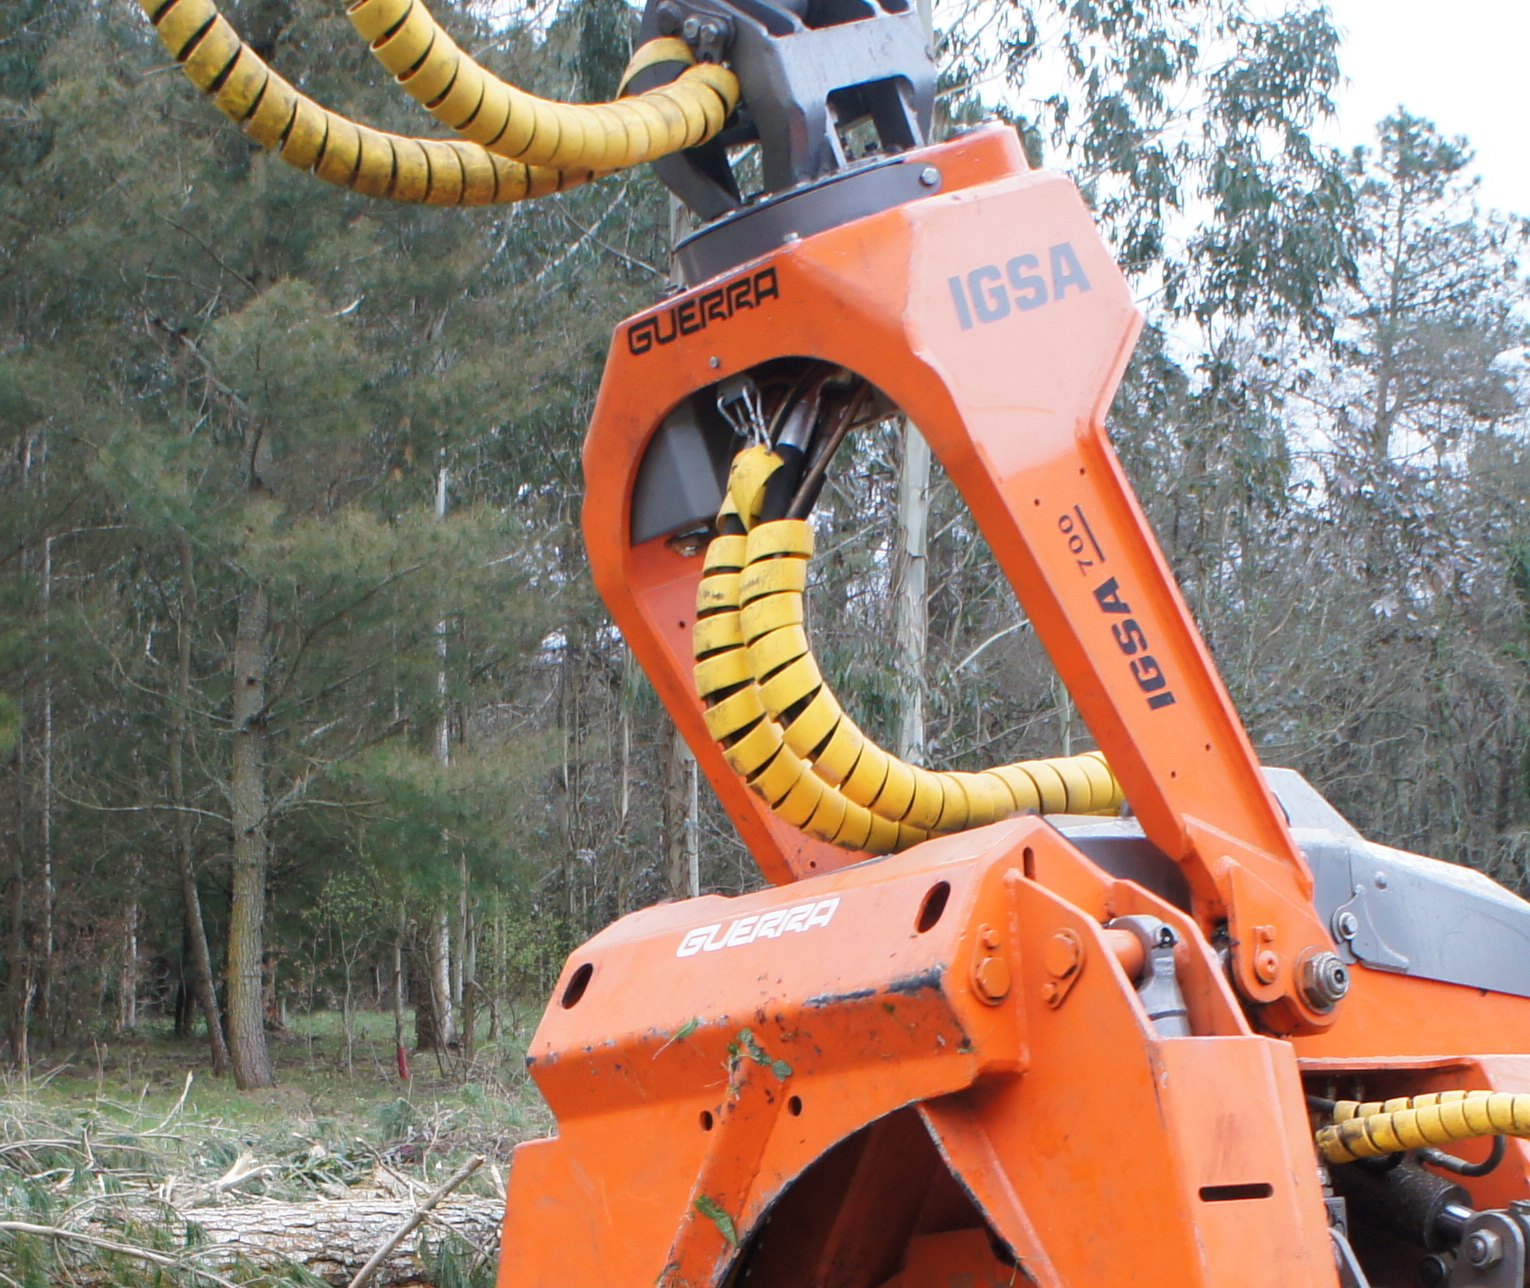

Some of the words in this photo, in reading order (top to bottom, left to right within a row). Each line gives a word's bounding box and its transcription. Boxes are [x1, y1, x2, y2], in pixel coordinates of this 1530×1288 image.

[628, 267, 780, 355] GUERRA
[947, 242, 1091, 330] IGSA
[1058, 514, 1095, 577] 700
[1093, 576, 1176, 711] IGSA
[677, 897, 841, 958] GUERRA
